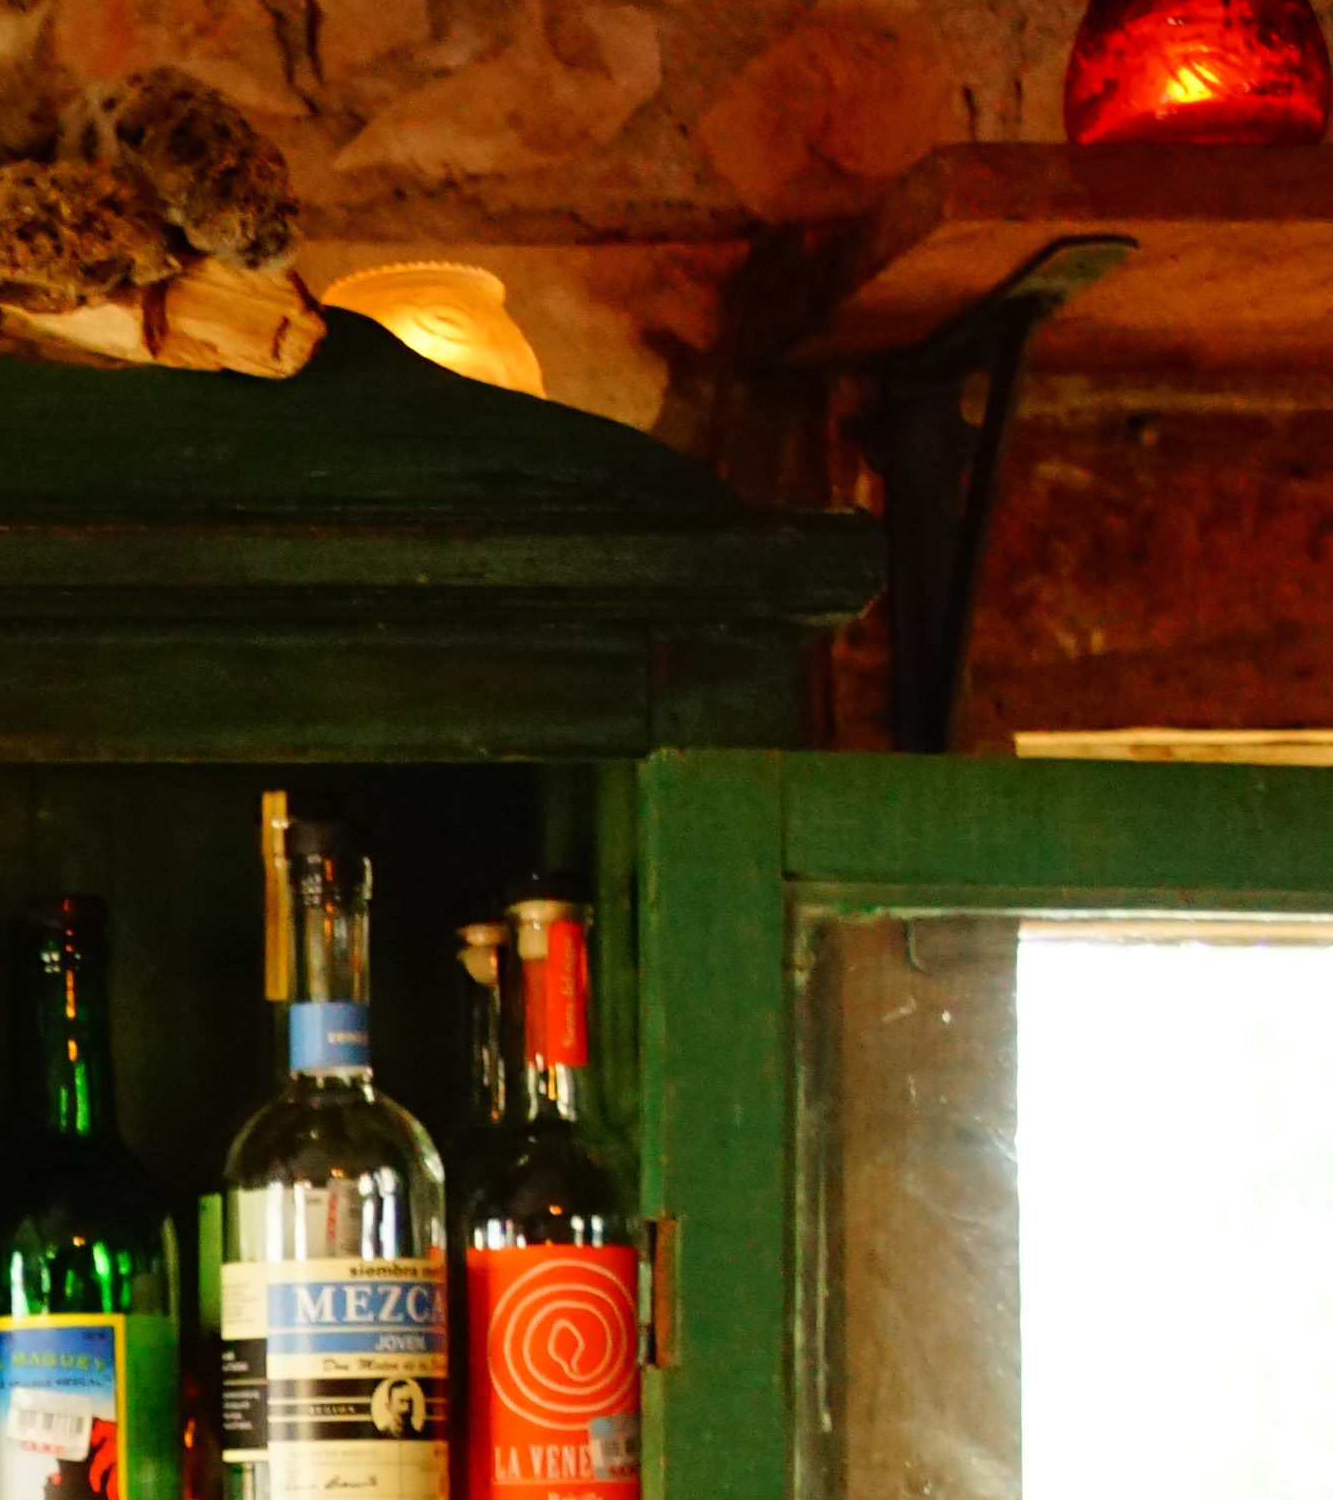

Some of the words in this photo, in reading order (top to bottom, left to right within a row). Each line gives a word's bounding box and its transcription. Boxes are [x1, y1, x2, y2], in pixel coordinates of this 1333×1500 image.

[294, 1284, 443, 1324] MEZC
[494, 1446, 521, 1479] LA
[530, 1445, 593, 1479] VENE
